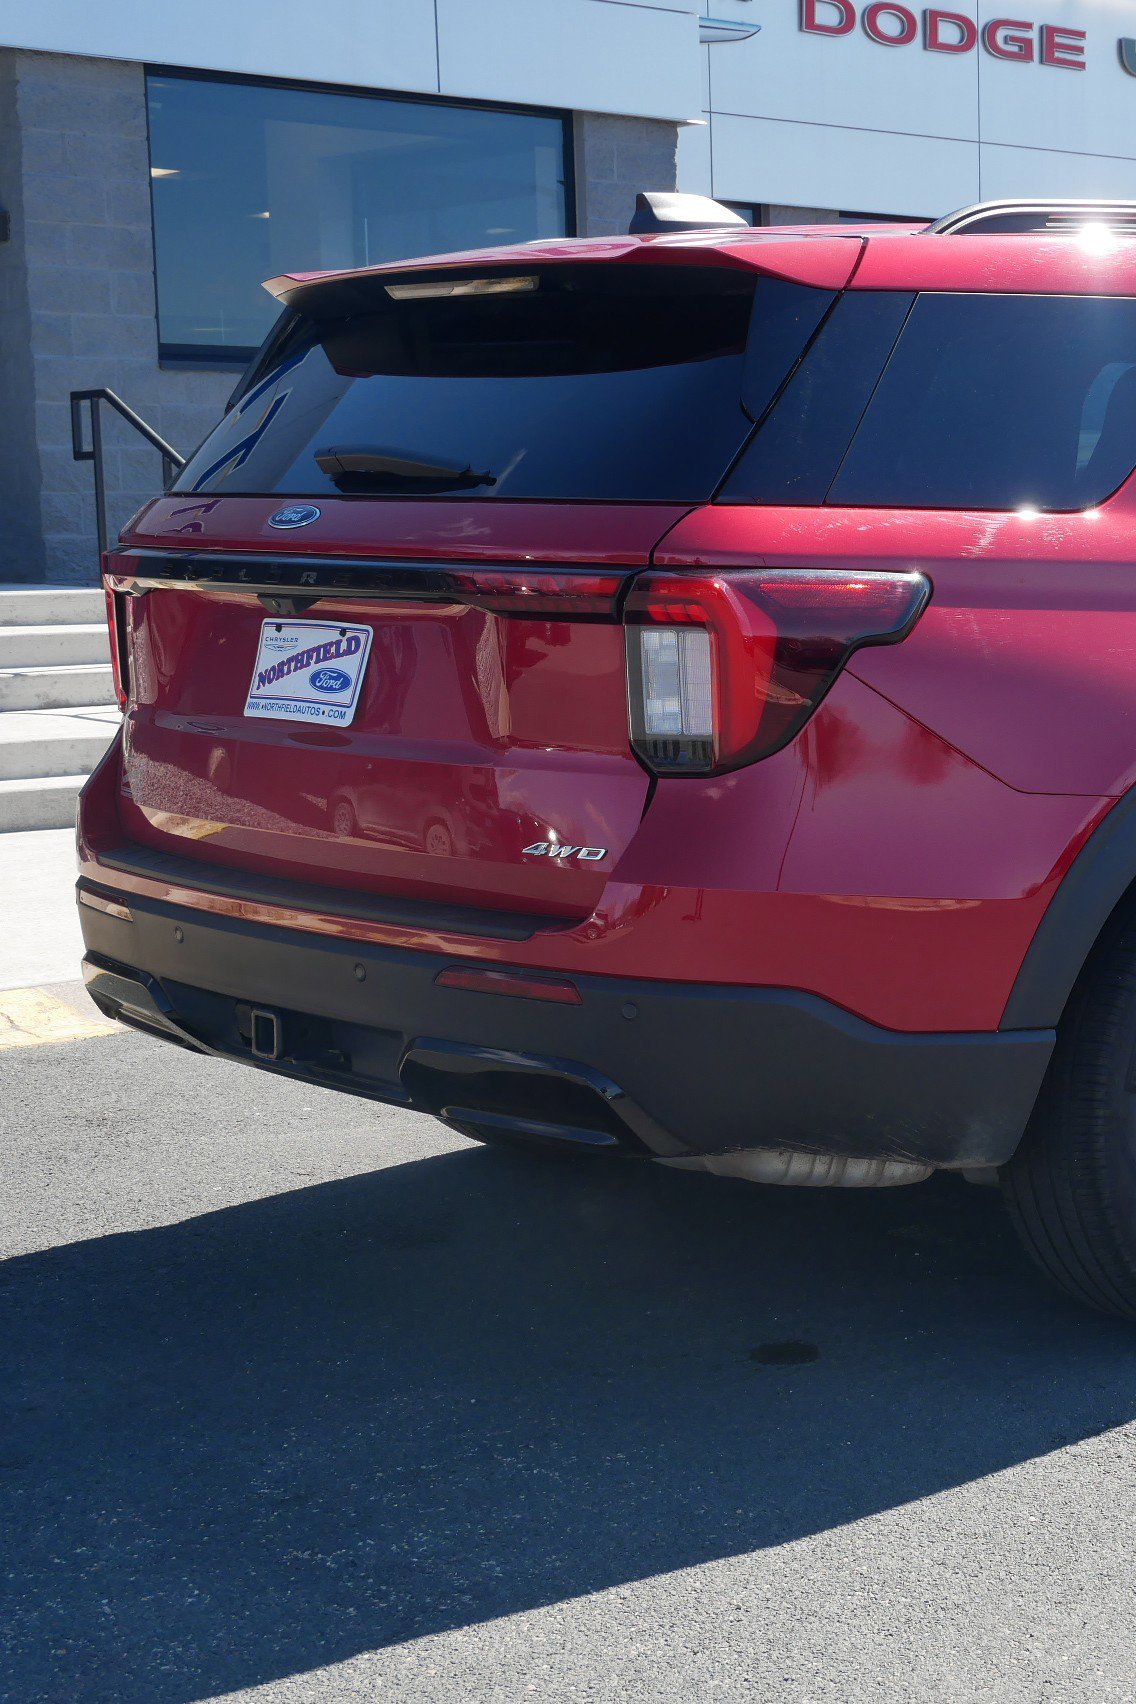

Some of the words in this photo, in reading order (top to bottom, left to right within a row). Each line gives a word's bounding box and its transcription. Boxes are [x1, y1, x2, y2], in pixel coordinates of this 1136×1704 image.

[800, 0, 1086, 71] DODGE
[256, 635, 361, 690] NORTHFIELD
[316, 671, 343, 689] Ford
[522, 842, 607, 861] 4WD
